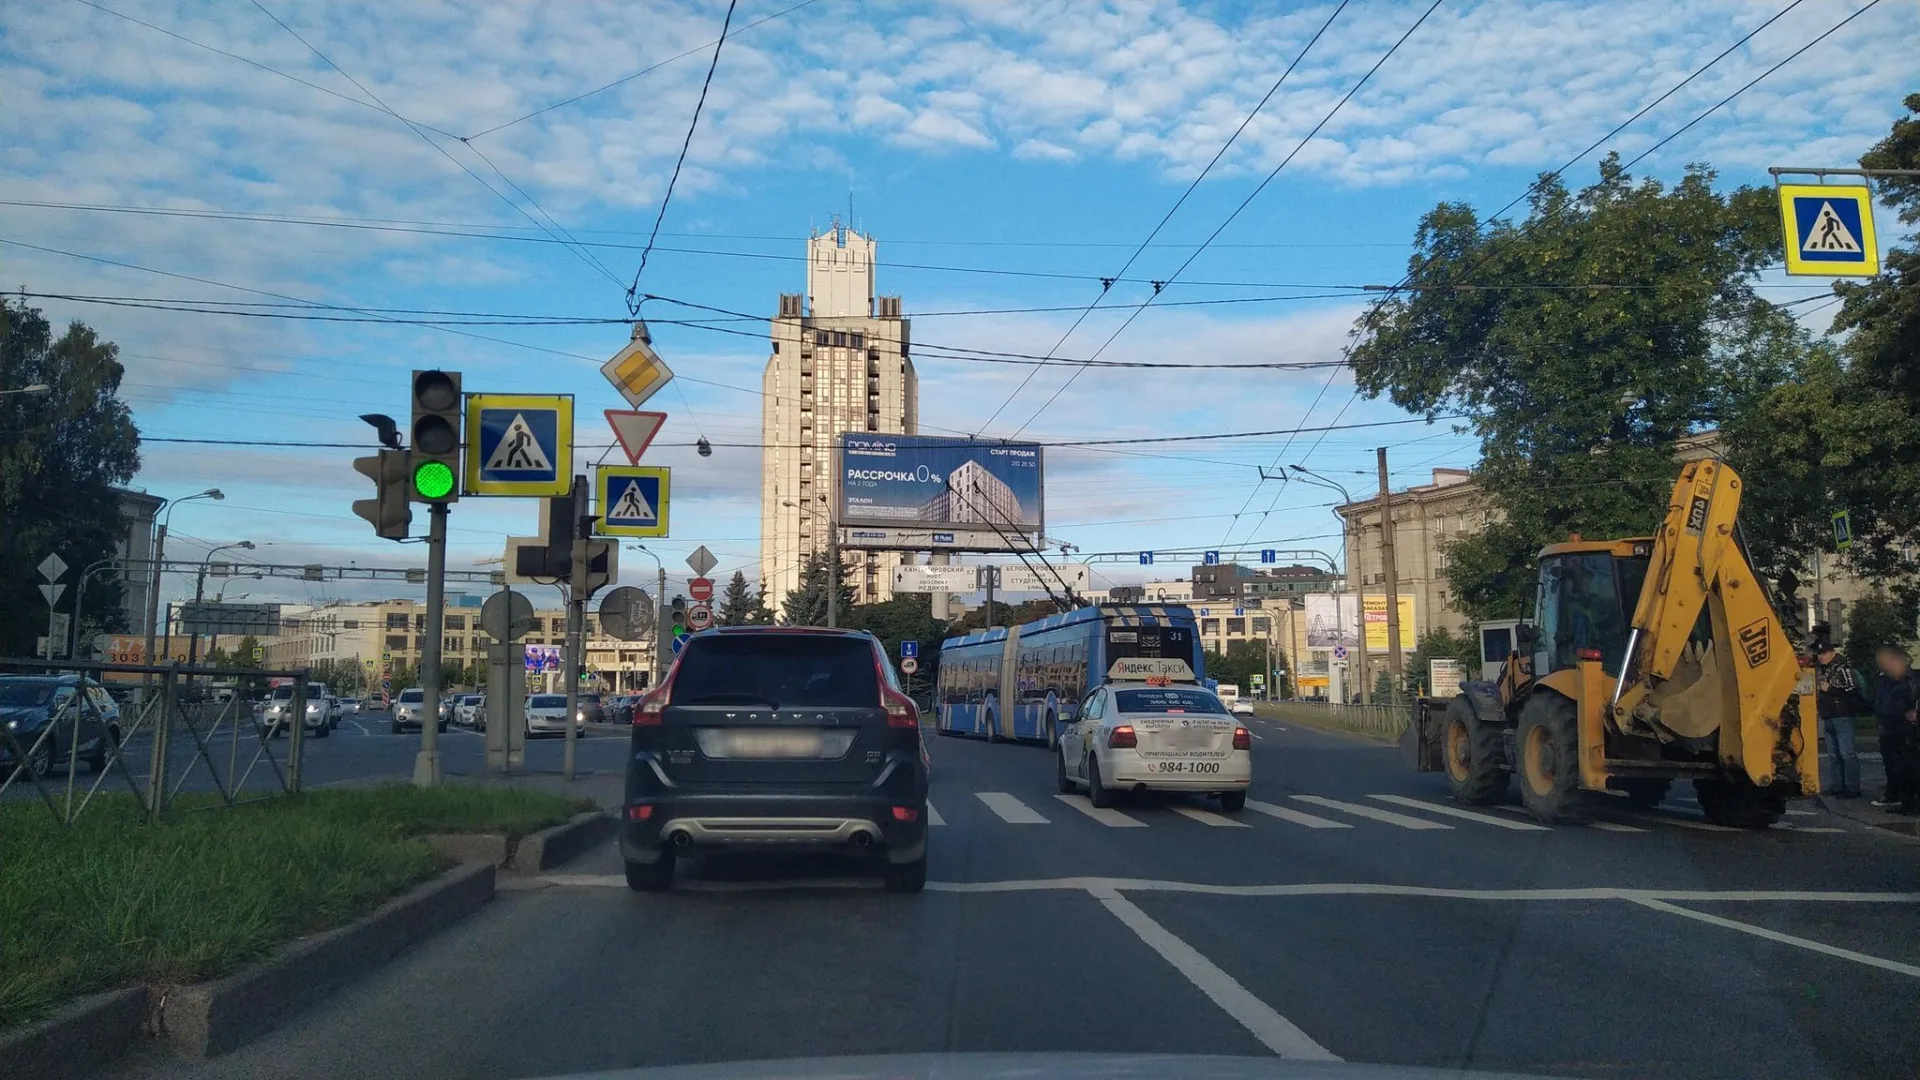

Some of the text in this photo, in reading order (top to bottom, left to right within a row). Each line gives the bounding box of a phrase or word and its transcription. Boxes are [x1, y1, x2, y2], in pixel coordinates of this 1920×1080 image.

[848, 469, 915, 482] РАССРОЧКА
[917, 465, 930, 483] 0
[1740, 626, 1768, 665] JCB
[1117, 661, 1185, 673] Яндекс Такси
[726, 713, 824, 721] VOLVO
[1159, 761, 1220, 774] 984-1000
